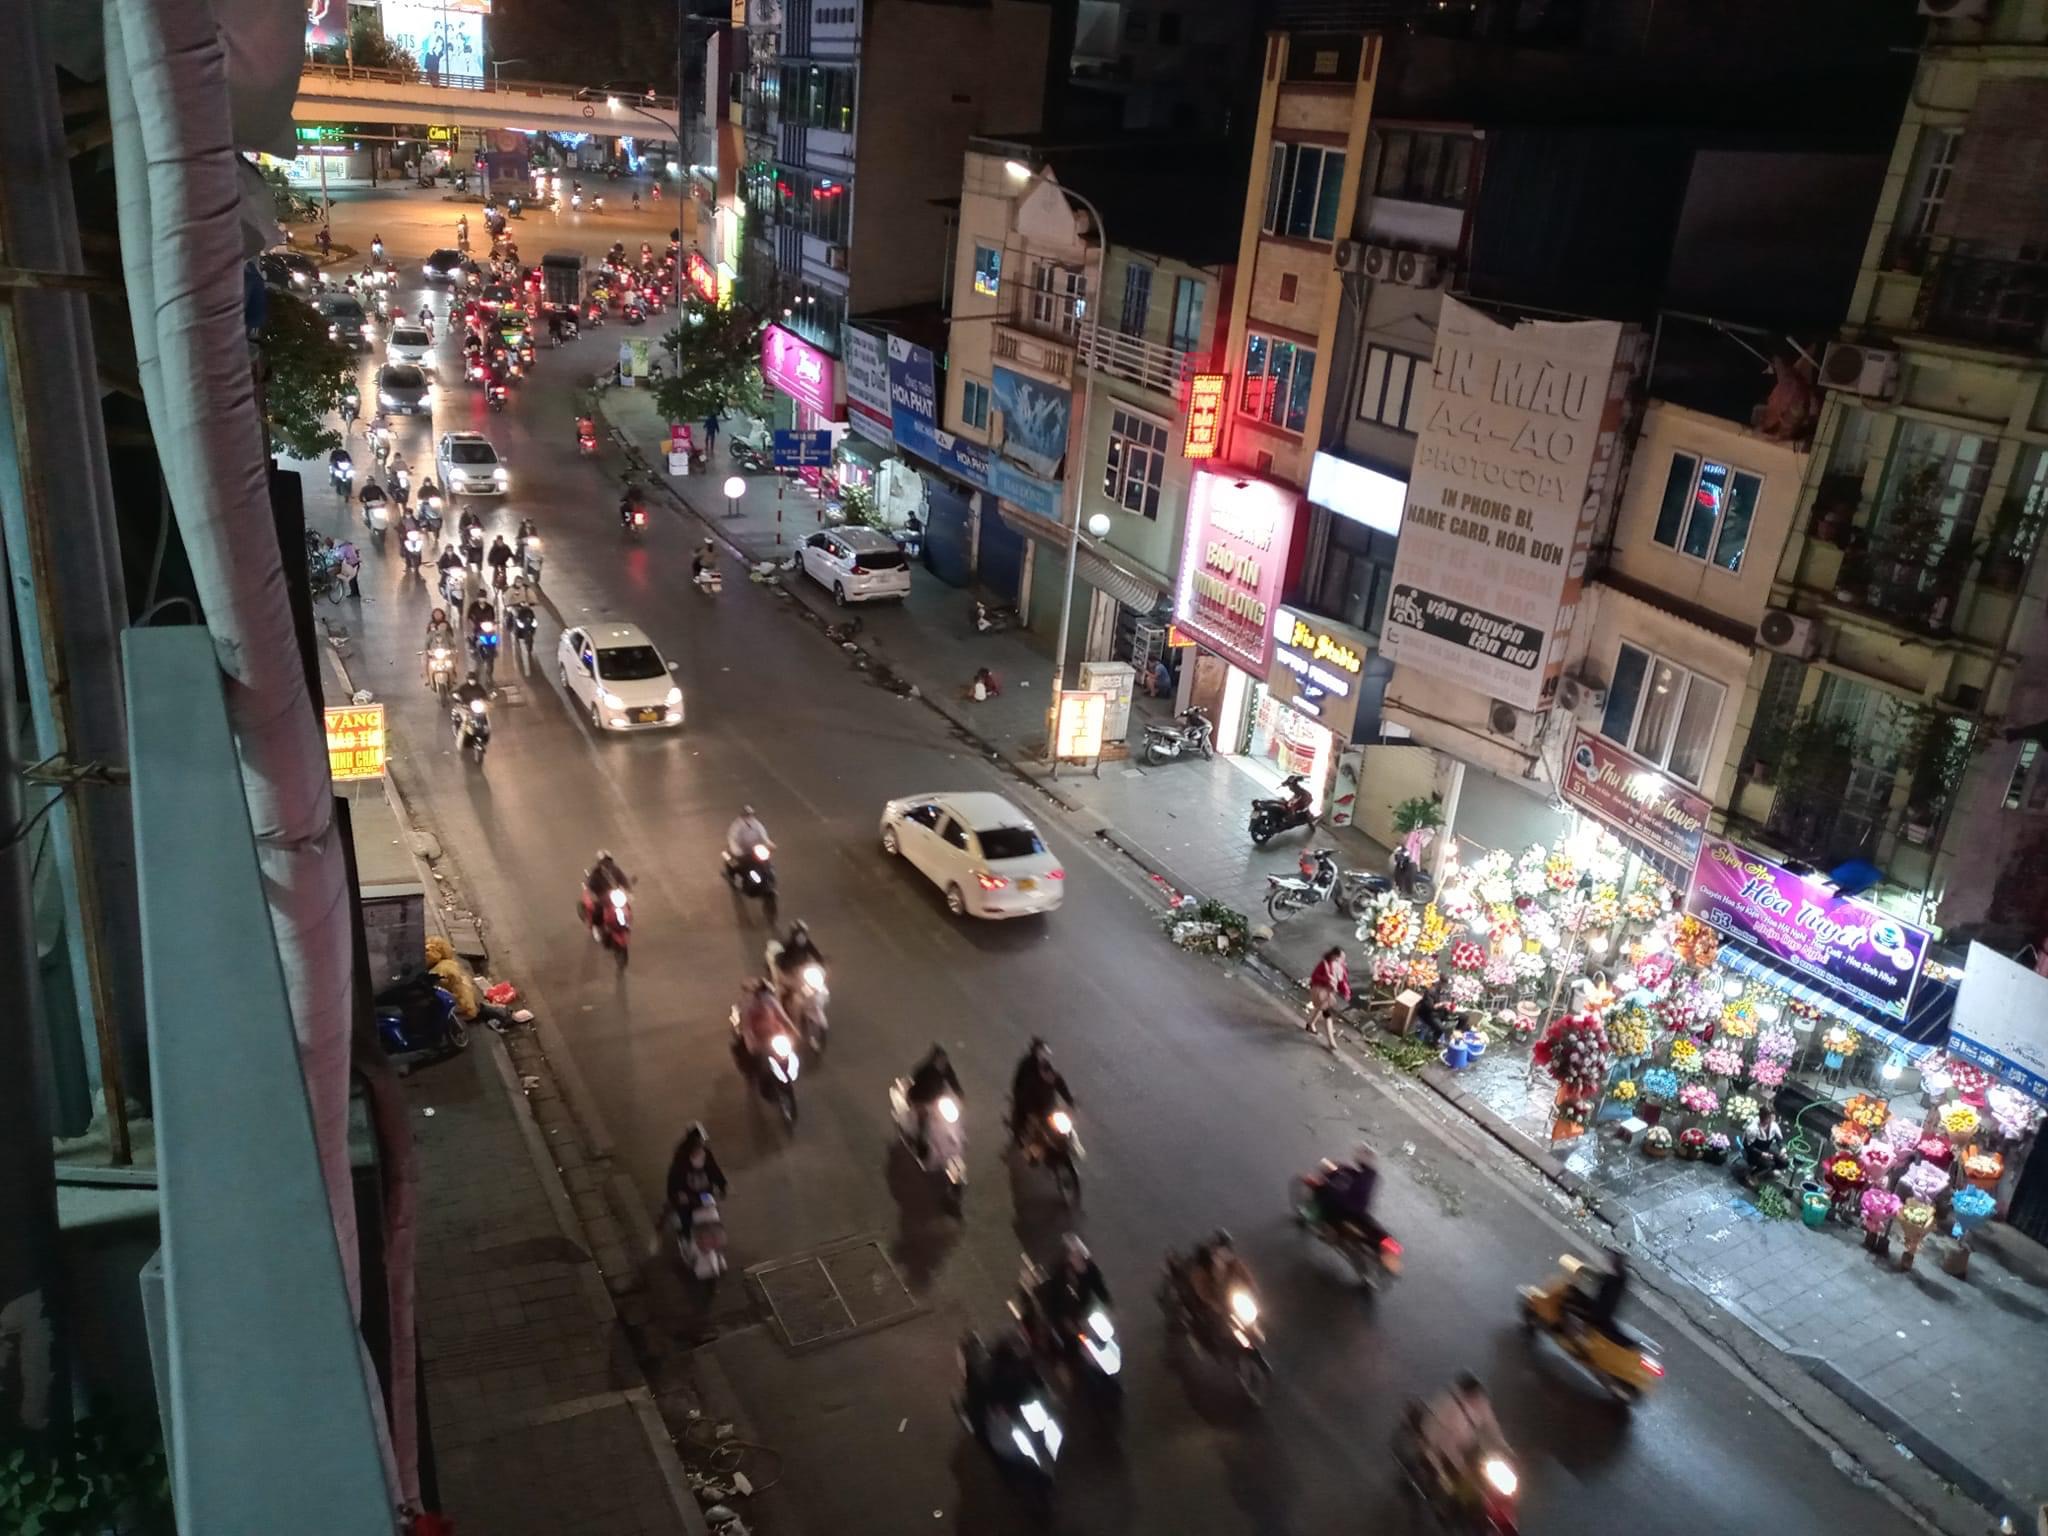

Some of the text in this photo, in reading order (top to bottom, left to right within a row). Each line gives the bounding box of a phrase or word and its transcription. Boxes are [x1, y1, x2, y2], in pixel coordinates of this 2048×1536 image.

[1491, 359, 1588, 420] MÀU
[1420, 443, 1570, 503] PHOTOCOPY
[1441, 487, 1459, 509] IN
[1461, 493, 1511, 523] PHONG
[1407, 504, 1447, 530] NAME
[1449, 515, 1491, 546] CARD,
[1226, 588, 1266, 627] LONG
[1426, 599, 1526, 645] vận chuyển
[1468, 631, 1501, 654] tận
[1503, 646, 1538, 668] nơi
[1573, 781, 1587, 796] 51
[1599, 758, 1621, 789] Thu
[1712, 847, 1744, 871] Shop
[1741, 880, 1791, 916] Hòa
[1711, 908, 1732, 930] 53
